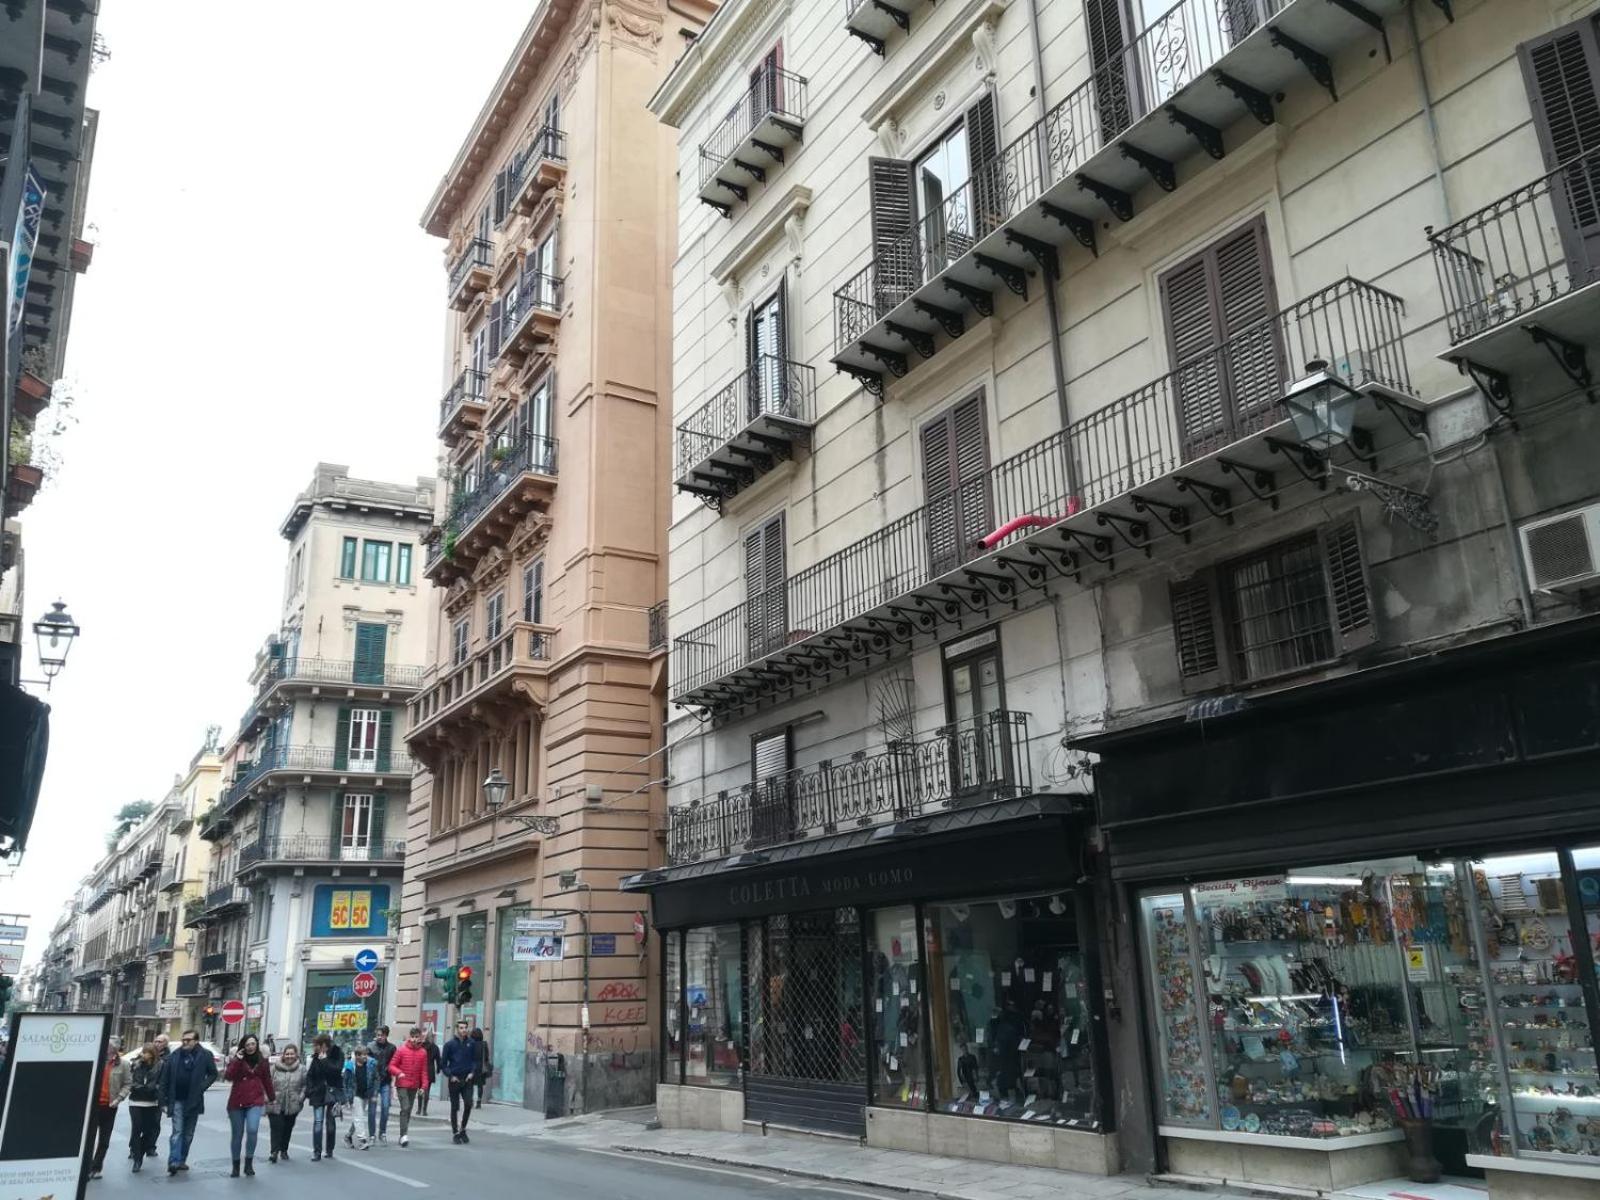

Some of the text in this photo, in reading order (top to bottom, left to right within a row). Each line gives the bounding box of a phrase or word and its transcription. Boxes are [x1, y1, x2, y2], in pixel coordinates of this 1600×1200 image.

[729, 867, 913, 904] COLETTA MODA UOMO
[1197, 881, 1237, 893] Beauty
[355, 979, 375, 990] STOP
